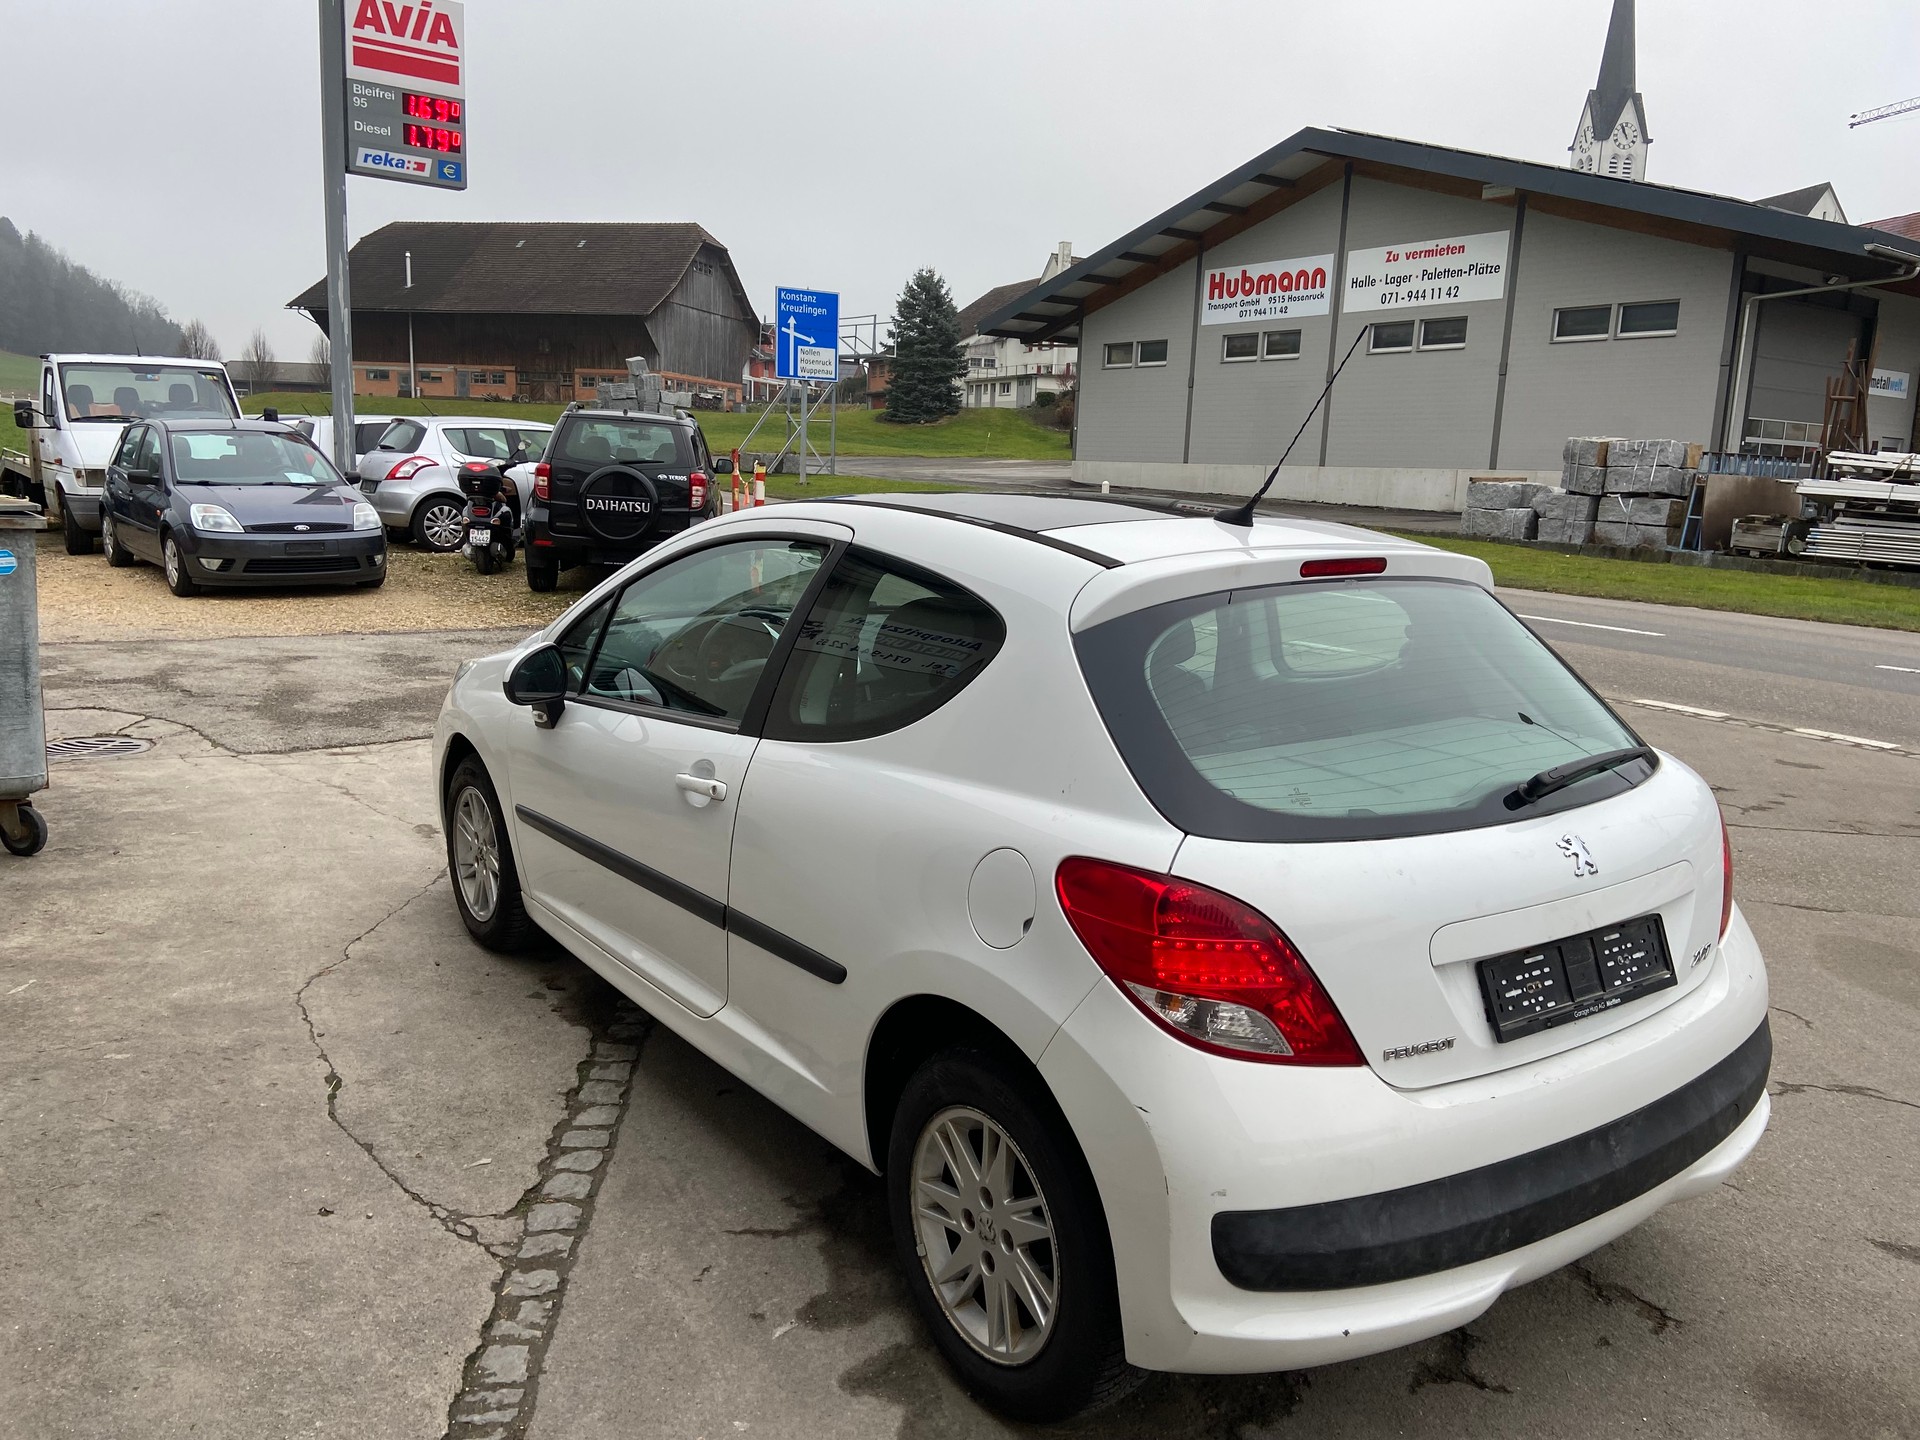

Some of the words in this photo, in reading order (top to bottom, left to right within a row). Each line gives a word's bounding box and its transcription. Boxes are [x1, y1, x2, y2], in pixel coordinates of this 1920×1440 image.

[353, 83, 395, 100] Bleifrei
[353, 97, 368, 108] 95
[354, 120, 391, 136] Diesel
[1385, 250, 1399, 263] Zu
[1405, 244, 1466, 261] vermieten
[1351, 275, 1376, 289] Halle
[1385, 273, 1412, 288] Lager
[1421, 262, 1501, 282] Paletten-Plätze
[1208, 267, 1327, 300] Hubmann
[781, 290, 817, 303] Konstanz
[1431, 287, 1442, 300] 11
[1446, 285, 1460, 298] 42
[1208, 301, 1238, 311] Transport
[1240, 298, 1260, 308] GmbH
[1268, 295, 1286, 304] 9515
[1287, 291, 1325, 302] Hosenruck
[781, 302, 827, 316] Kreuzlingen
[1239, 309, 1252, 318] 071
[1254, 307, 1267, 316] 944
[1269, 306, 1277, 315] 11
[1279, 306, 1288, 314] 42
[800, 348, 820, 356] Nollen
[800, 357, 832, 366] Hosenruck
[800, 366, 833, 376] Wuppenau
[586, 498, 650, 513] DAIHATSU
[1382, 1036, 1457, 1061] PEUGEOT
